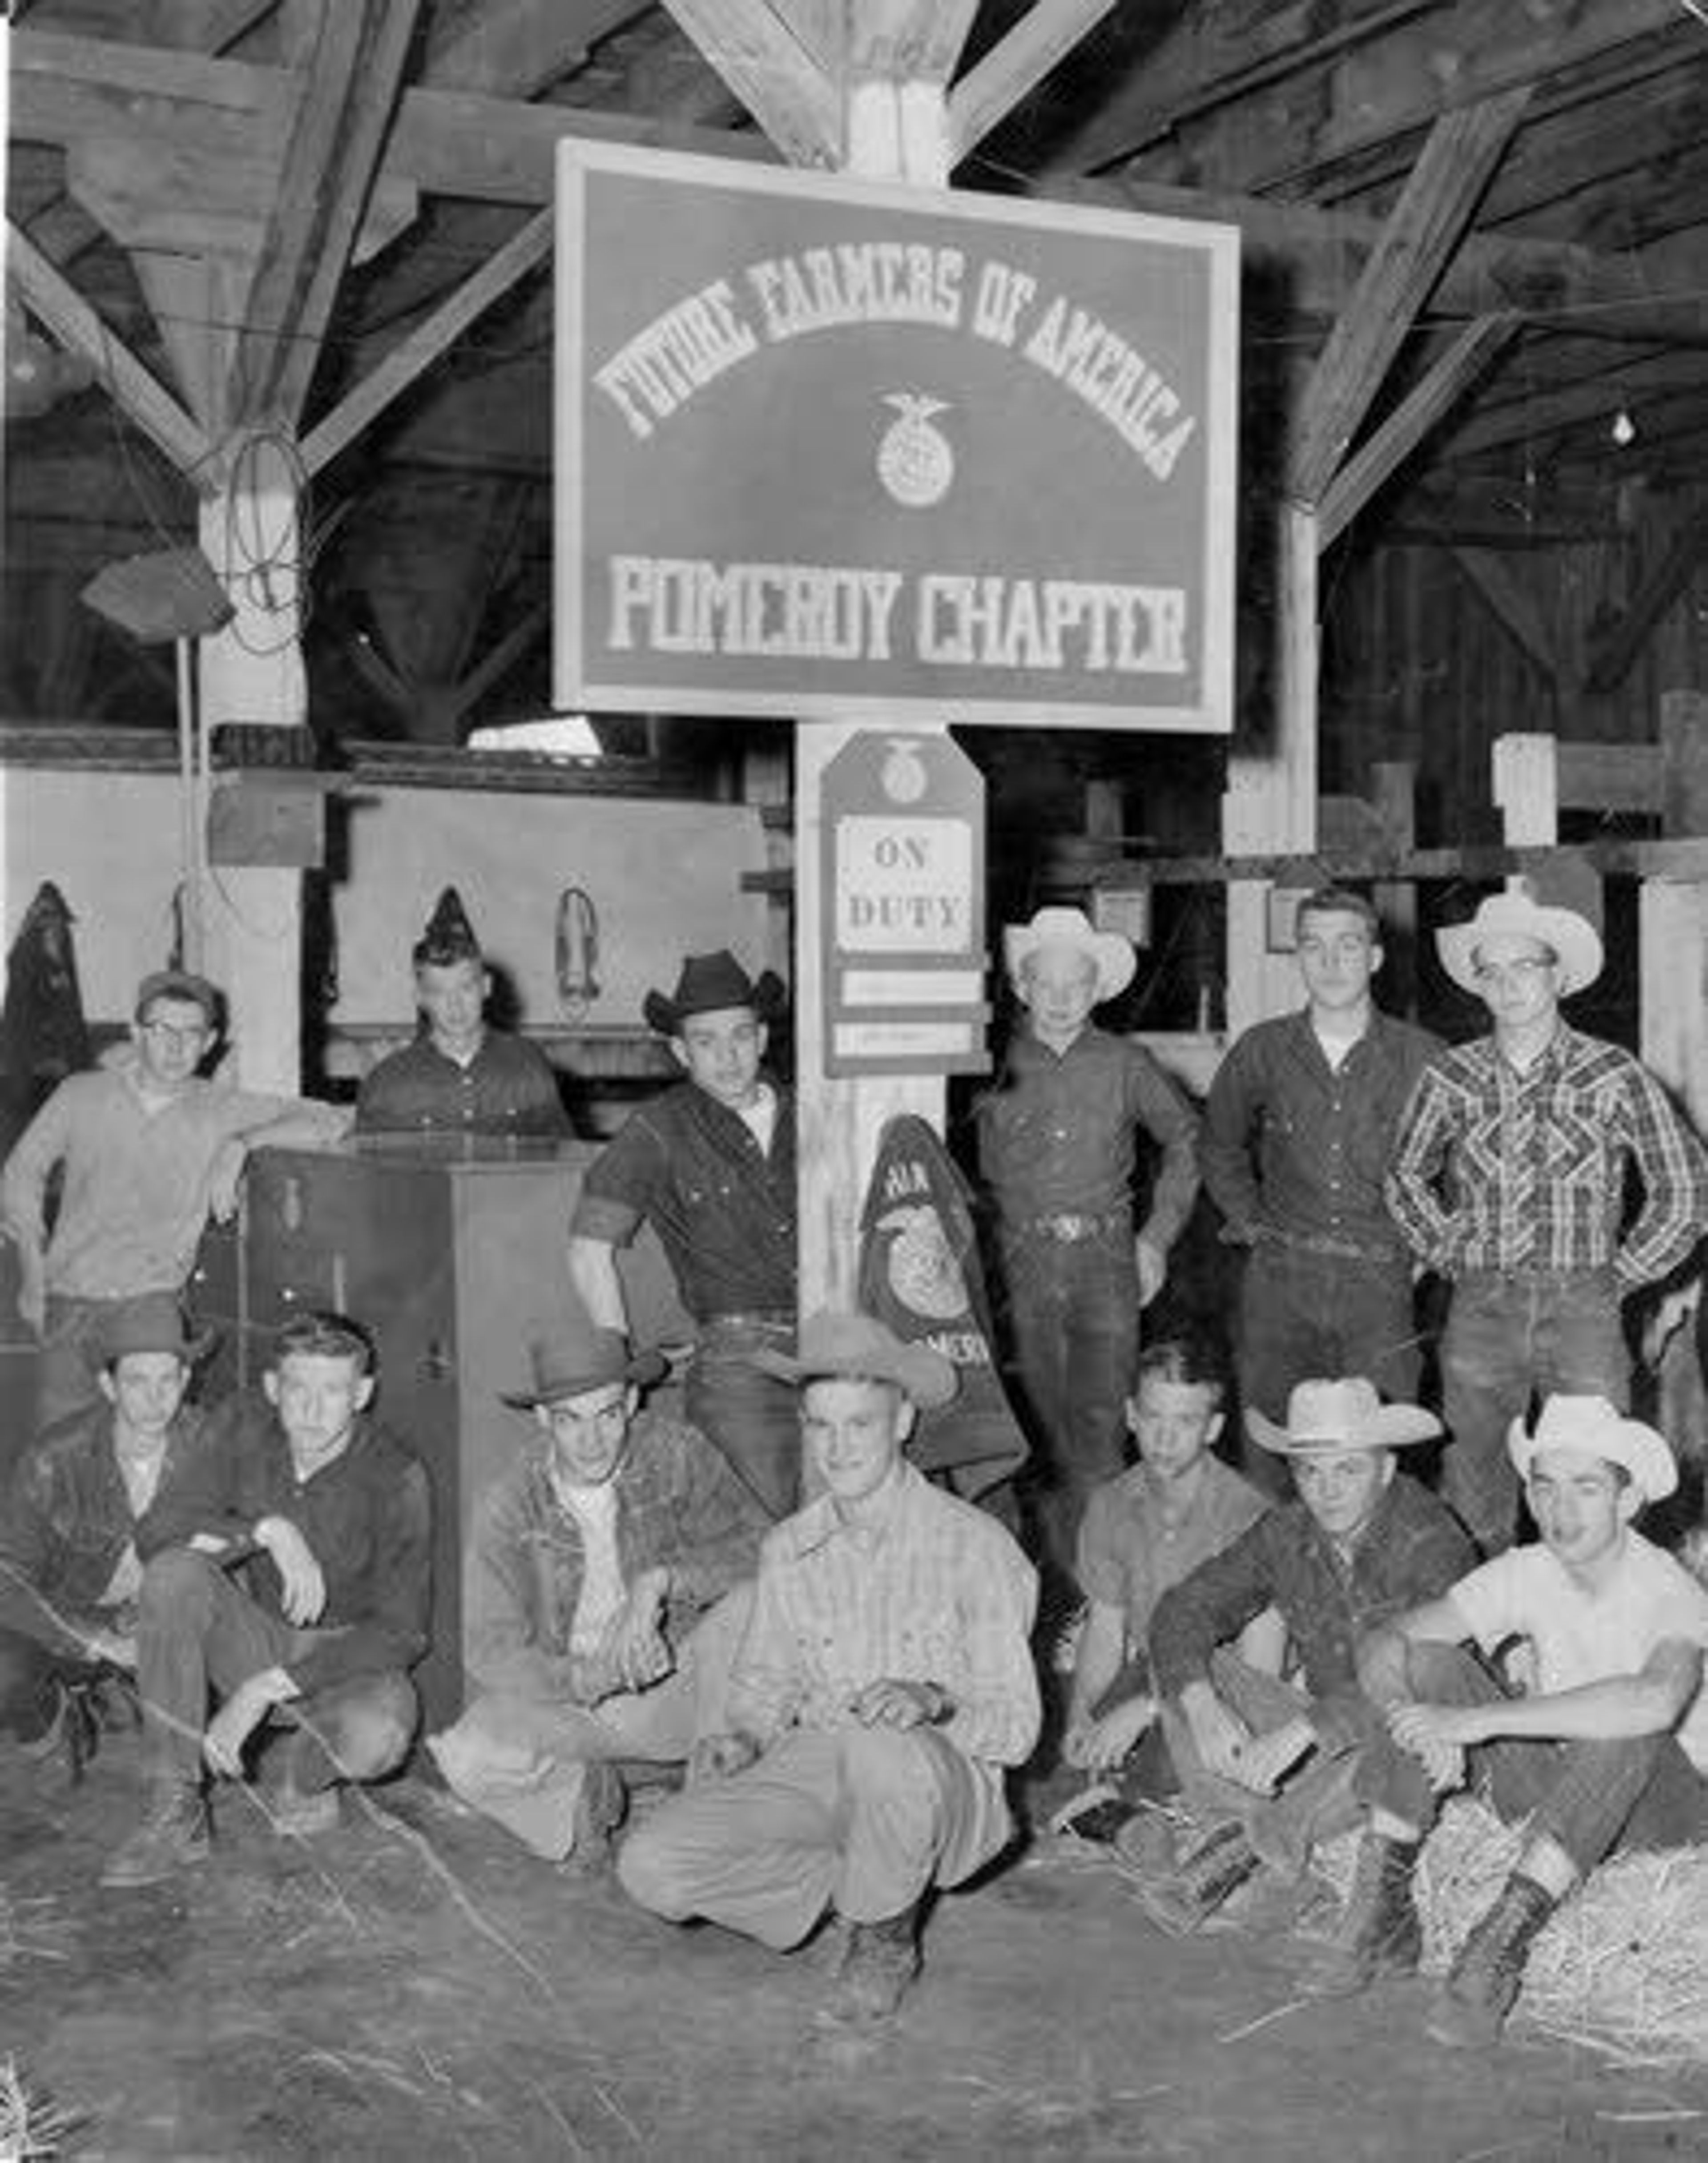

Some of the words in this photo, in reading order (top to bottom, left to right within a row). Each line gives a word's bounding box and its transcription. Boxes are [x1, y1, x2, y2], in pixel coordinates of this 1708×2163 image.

[591, 278, 759, 439] FUTURE
[747, 242, 964, 342] FARMERS
[971, 261, 1037, 347] OF
[1022, 295, 1196, 480] AMERICA
[607, 556, 903, 659] POMEROY
[918, 573, 1188, 674] CHAPTER
[875, 836, 928, 868] ON
[849, 895, 961, 928] DUTY
